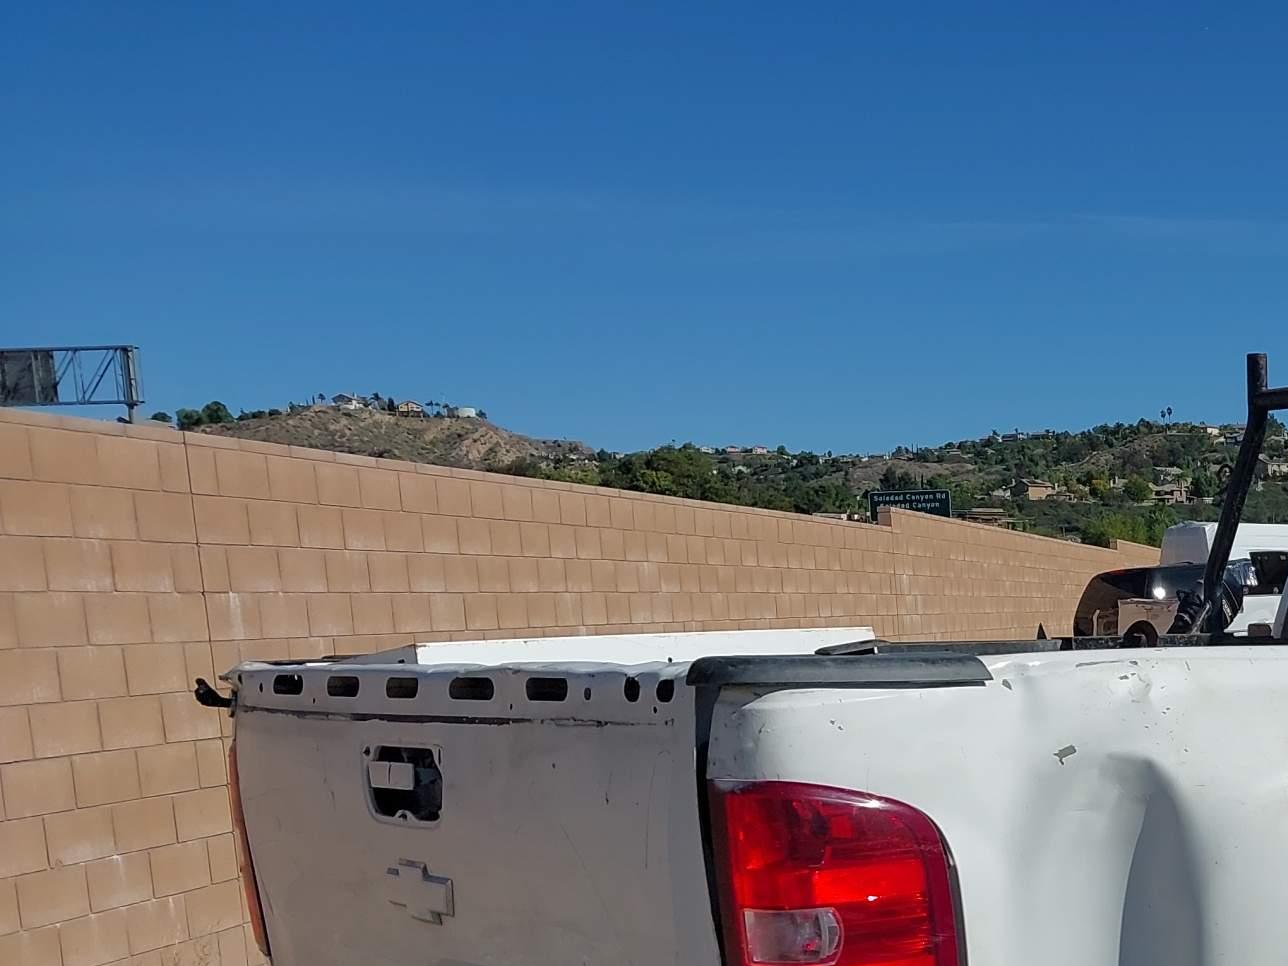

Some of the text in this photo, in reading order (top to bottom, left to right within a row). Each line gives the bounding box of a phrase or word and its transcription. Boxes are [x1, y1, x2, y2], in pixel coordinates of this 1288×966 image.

[873, 492, 946, 502] Soledad Canyon Rd
[912, 502, 940, 510] Canyon
